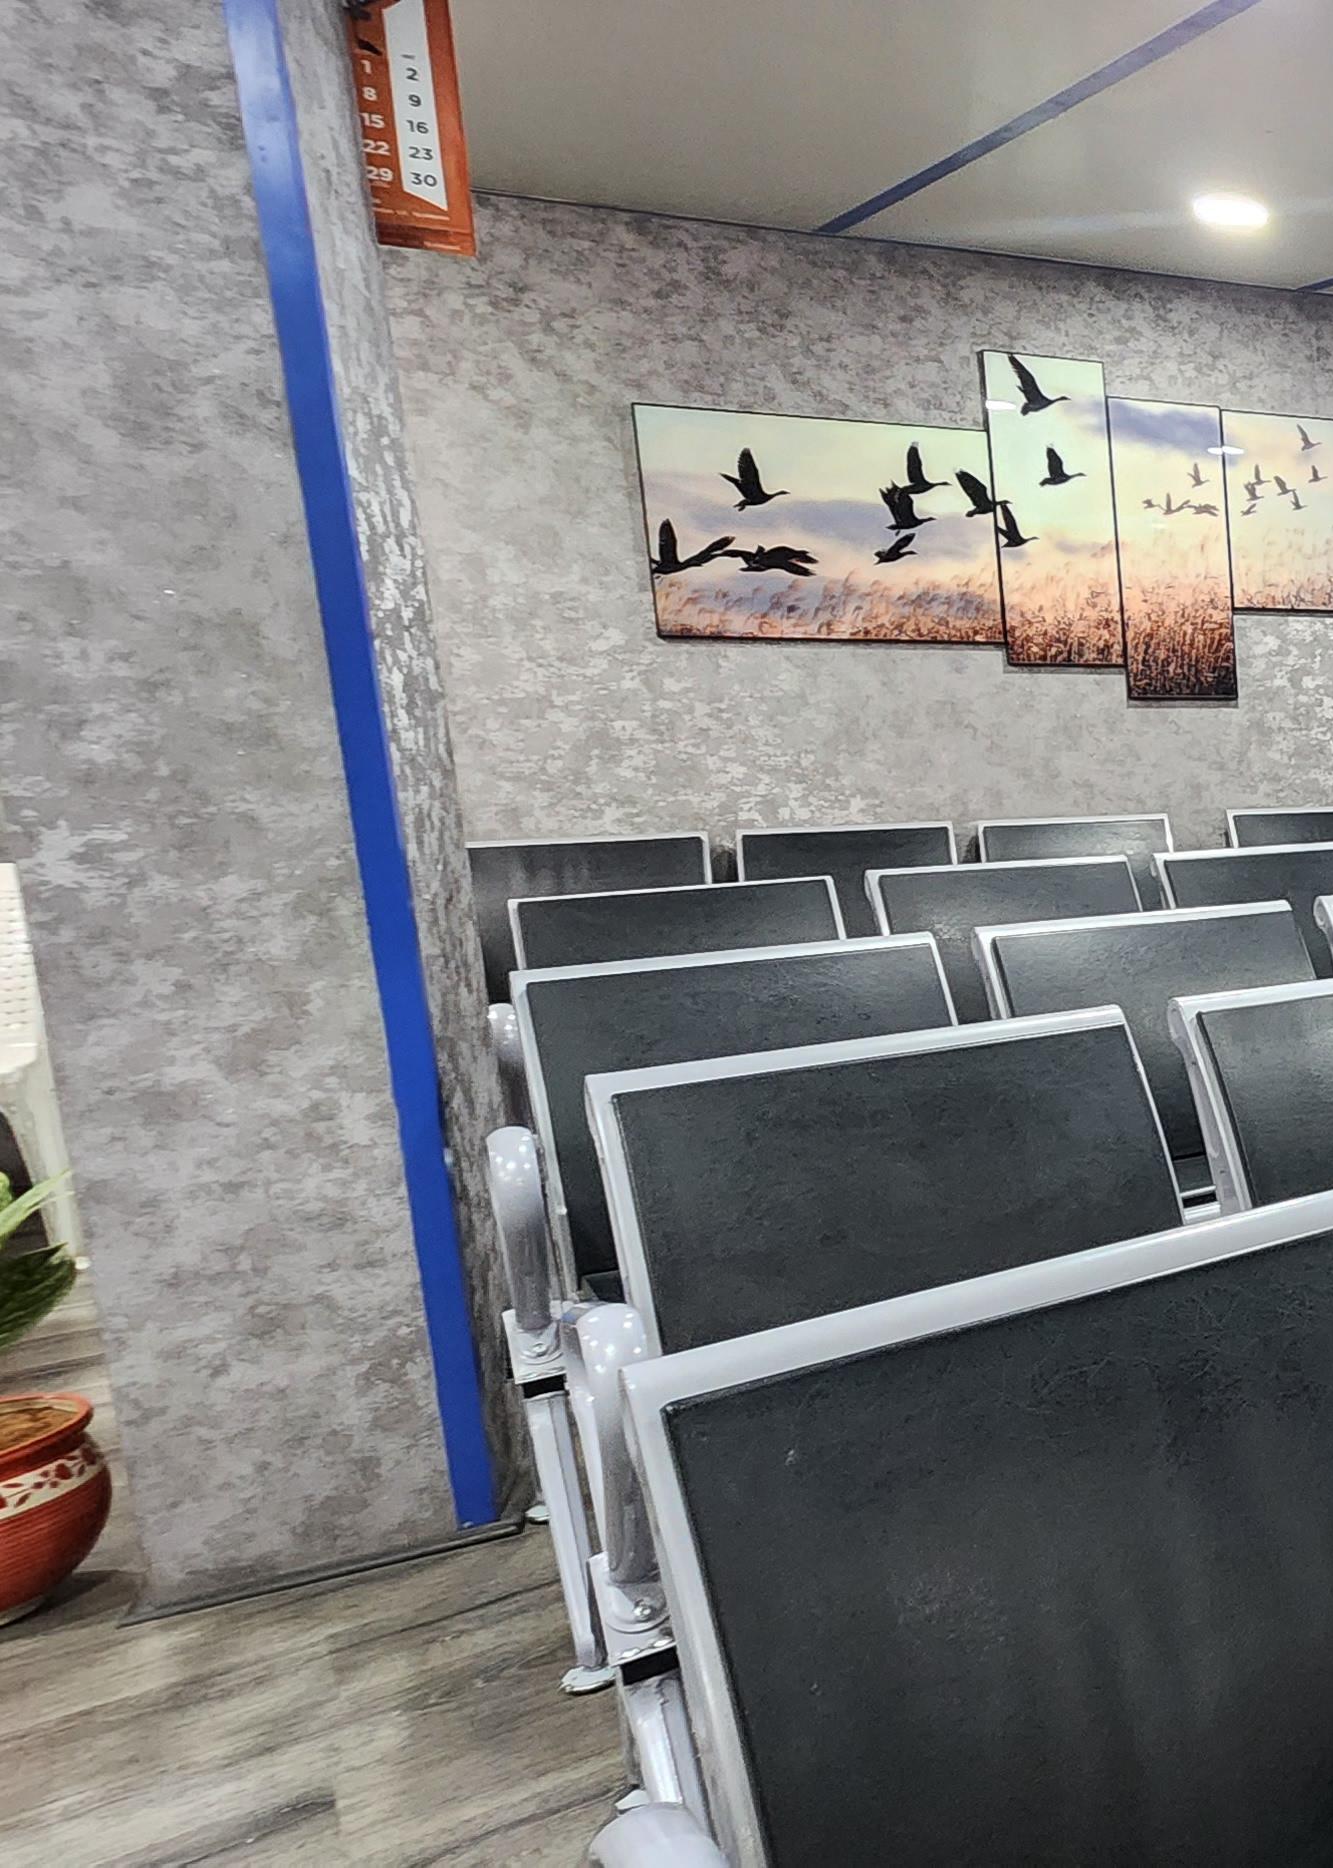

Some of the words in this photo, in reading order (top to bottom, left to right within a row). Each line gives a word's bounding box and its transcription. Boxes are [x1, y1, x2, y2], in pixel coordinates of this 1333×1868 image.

[360, 59, 372, 75] 1
[406, 67, 419, 81] 2
[362, 86, 378, 101] 8
[408, 94, 422, 107] 9
[360, 112, 385, 129] 15
[406, 119, 429, 134] 16
[362, 139, 391, 156] 22
[408, 146, 434, 161] 23
[366, 166, 394, 182] 29
[410, 171, 438, 187] 30
